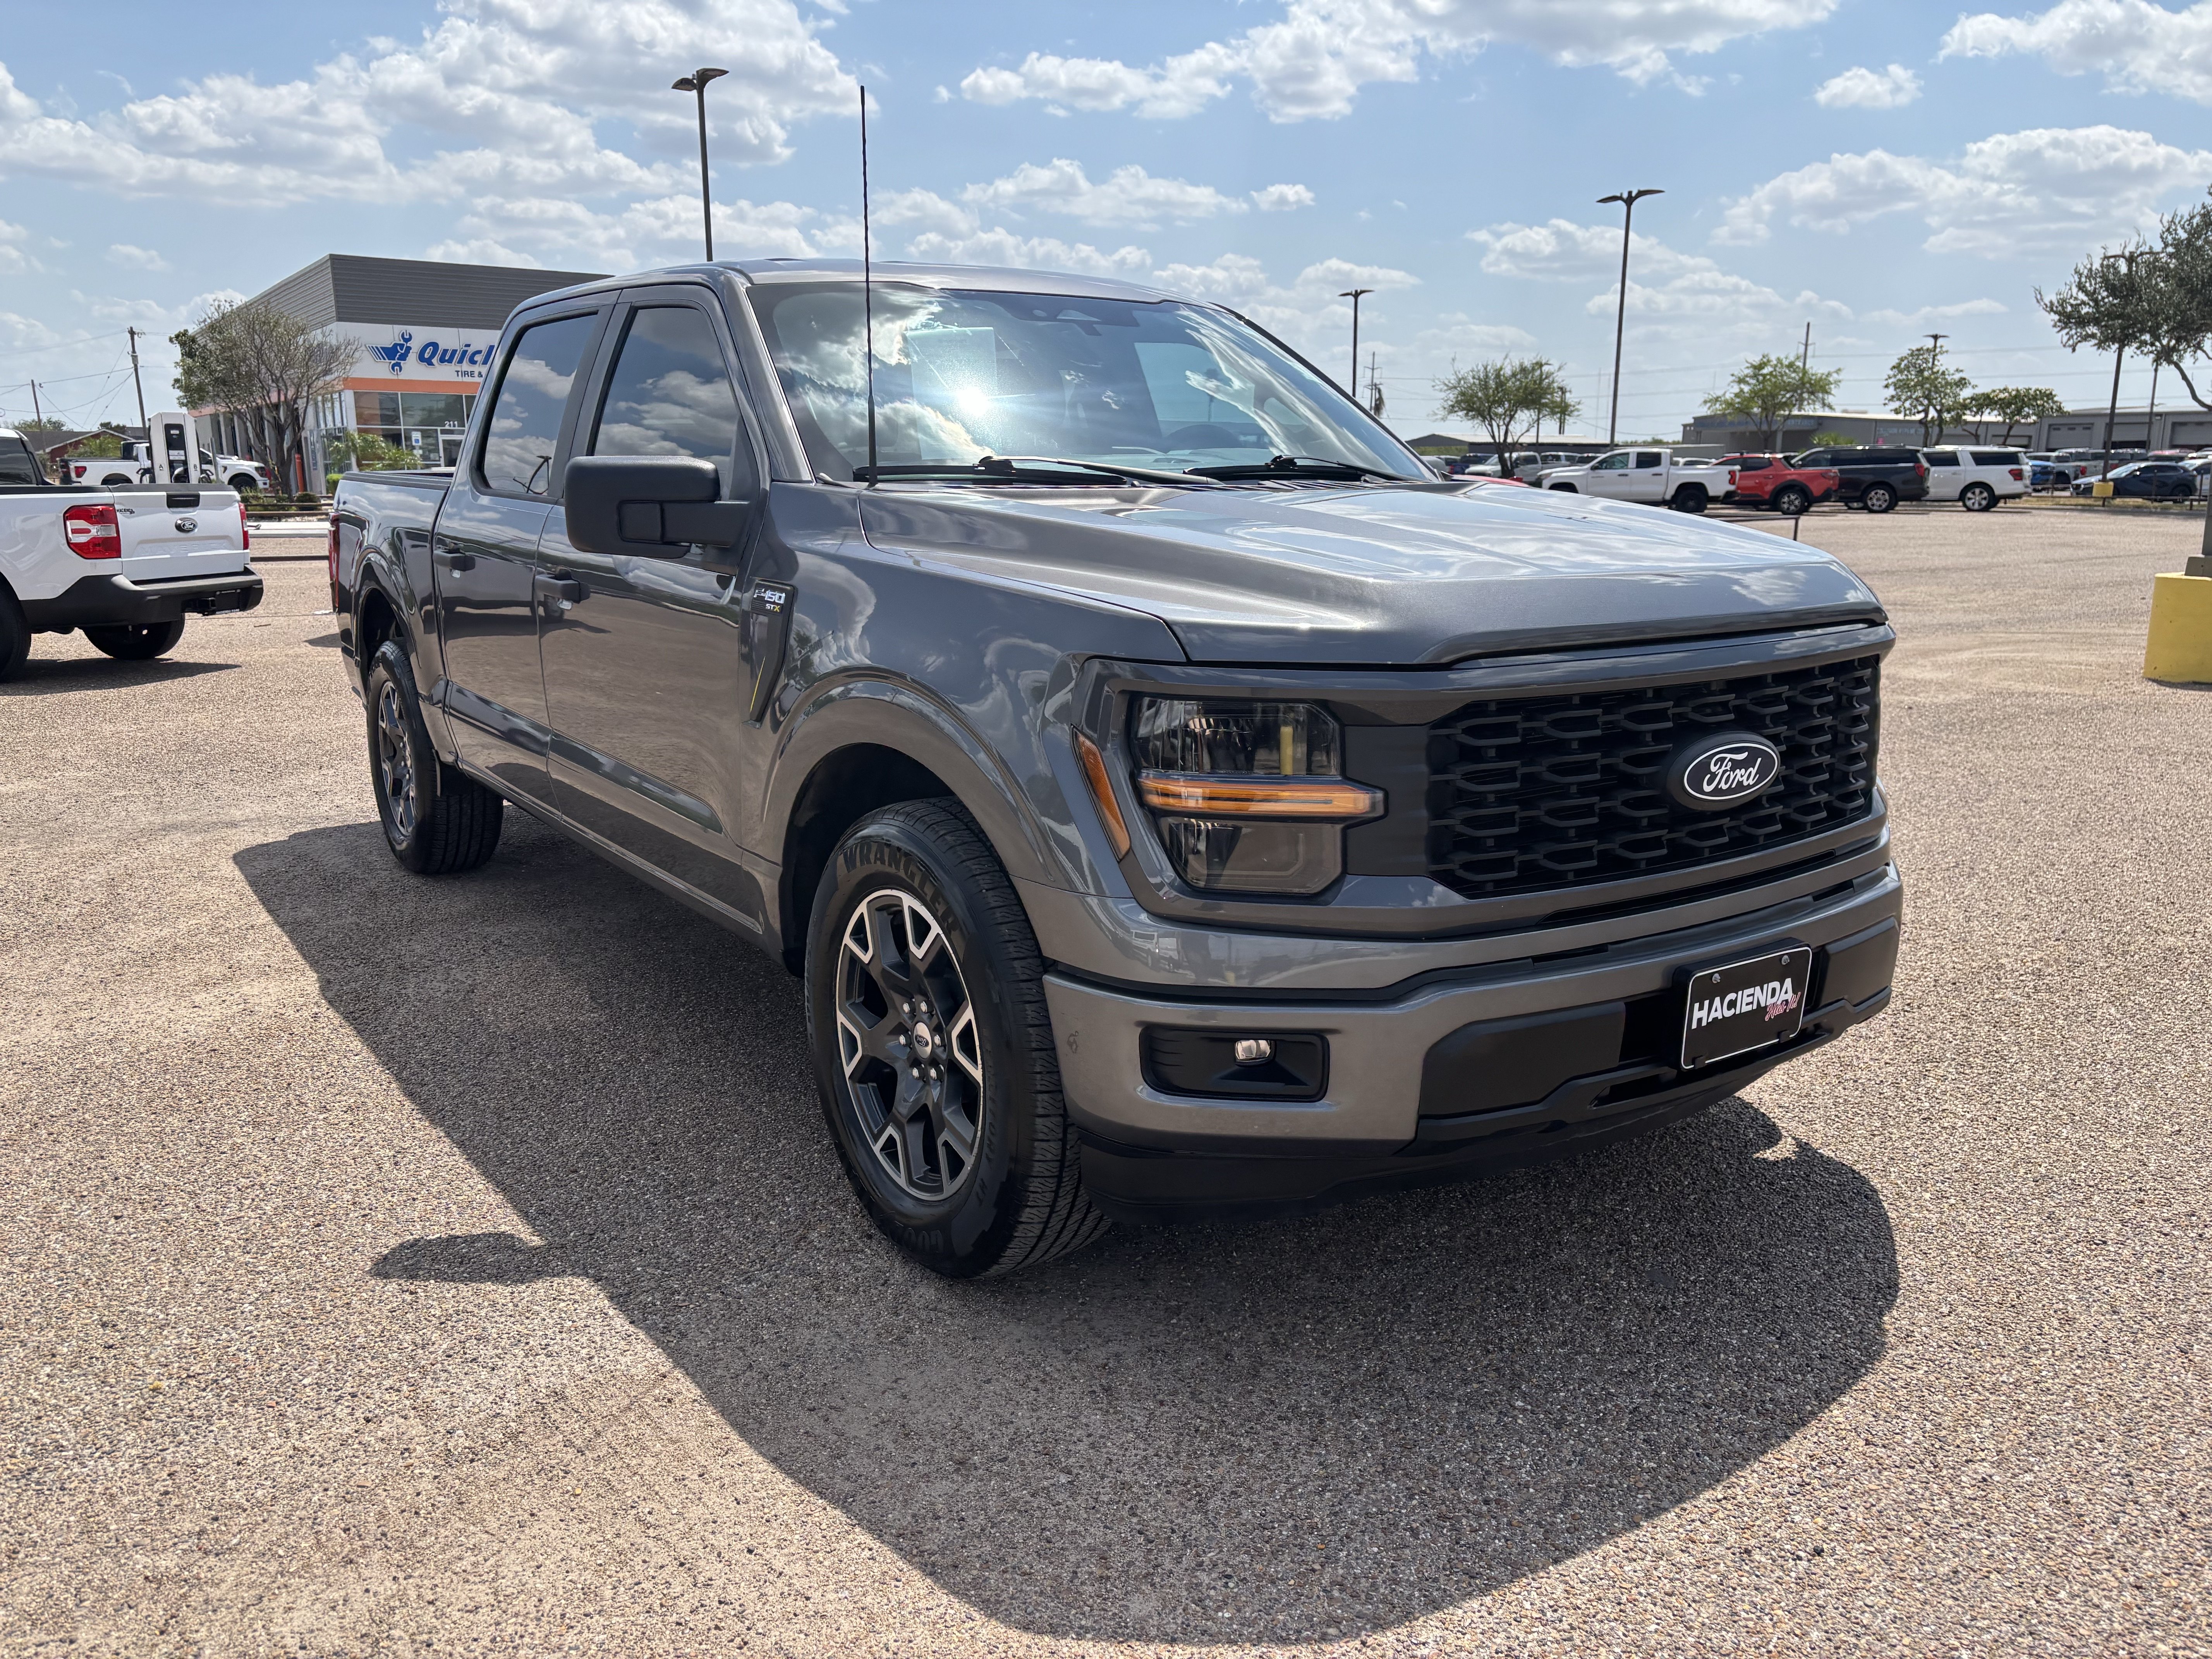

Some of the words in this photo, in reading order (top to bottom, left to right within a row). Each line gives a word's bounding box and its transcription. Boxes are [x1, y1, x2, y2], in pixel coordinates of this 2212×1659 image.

[754, 589, 785, 604] F-150
[766, 604, 780, 612] STX
[1703, 752, 1762, 792] Ford
[843, 841, 961, 936] WRANGLER
[1692, 978, 1793, 1029] HACIENDA
